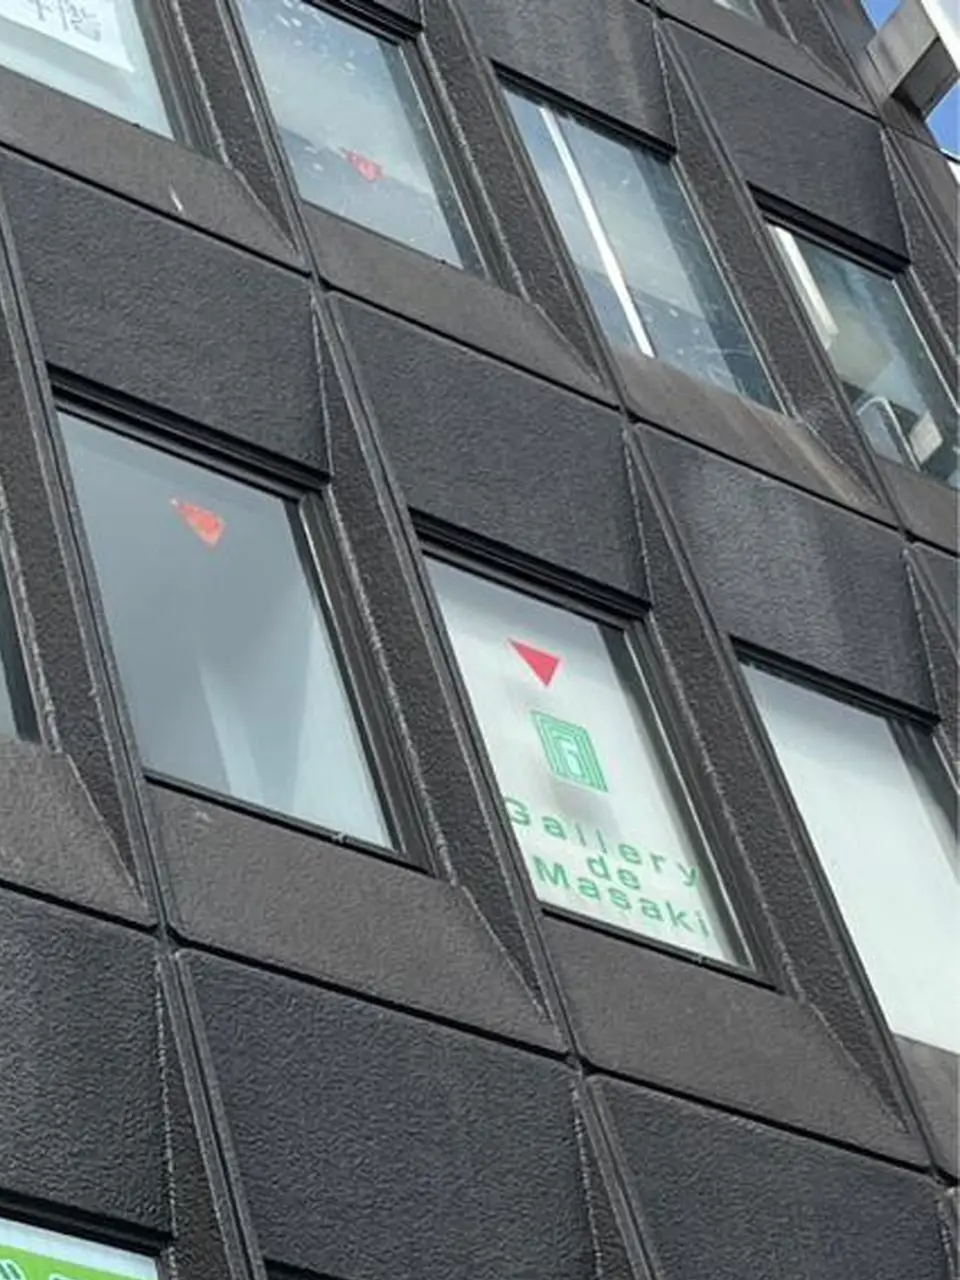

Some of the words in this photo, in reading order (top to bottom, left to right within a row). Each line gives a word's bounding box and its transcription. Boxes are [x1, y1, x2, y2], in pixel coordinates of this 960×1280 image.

[503, 797, 700, 889] Gallery
[586, 855, 643, 891] de
[533, 856, 710, 939] Masaki
